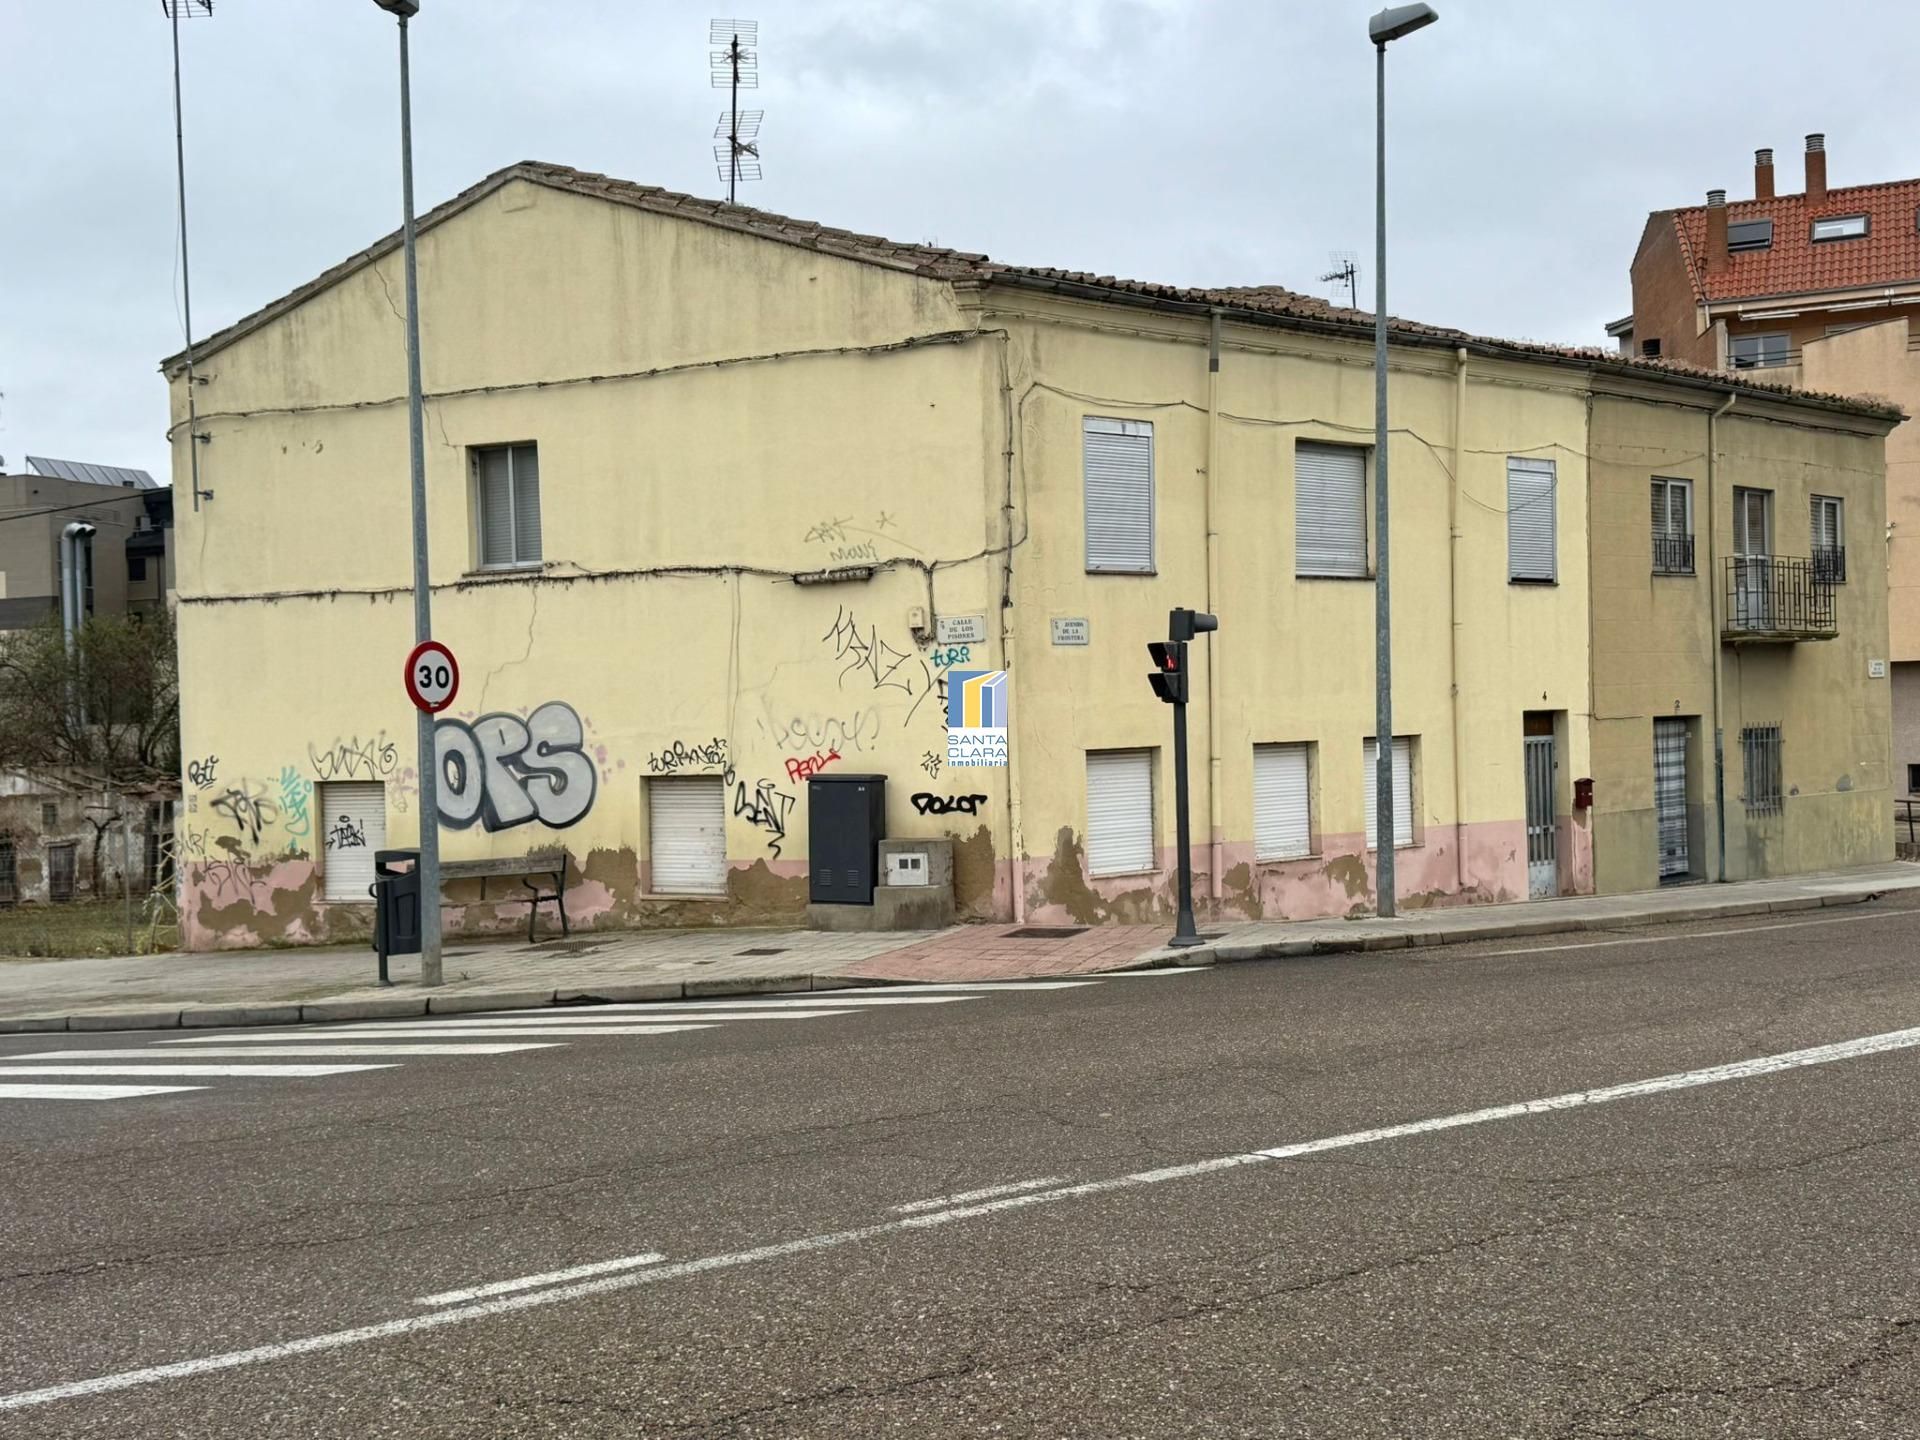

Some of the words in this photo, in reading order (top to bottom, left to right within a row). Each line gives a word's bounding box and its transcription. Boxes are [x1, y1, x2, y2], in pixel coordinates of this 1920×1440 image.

[947, 632, 975, 640] PISONES
[419, 665, 450, 689] 30
[1674, 699, 1681, 709] 2
